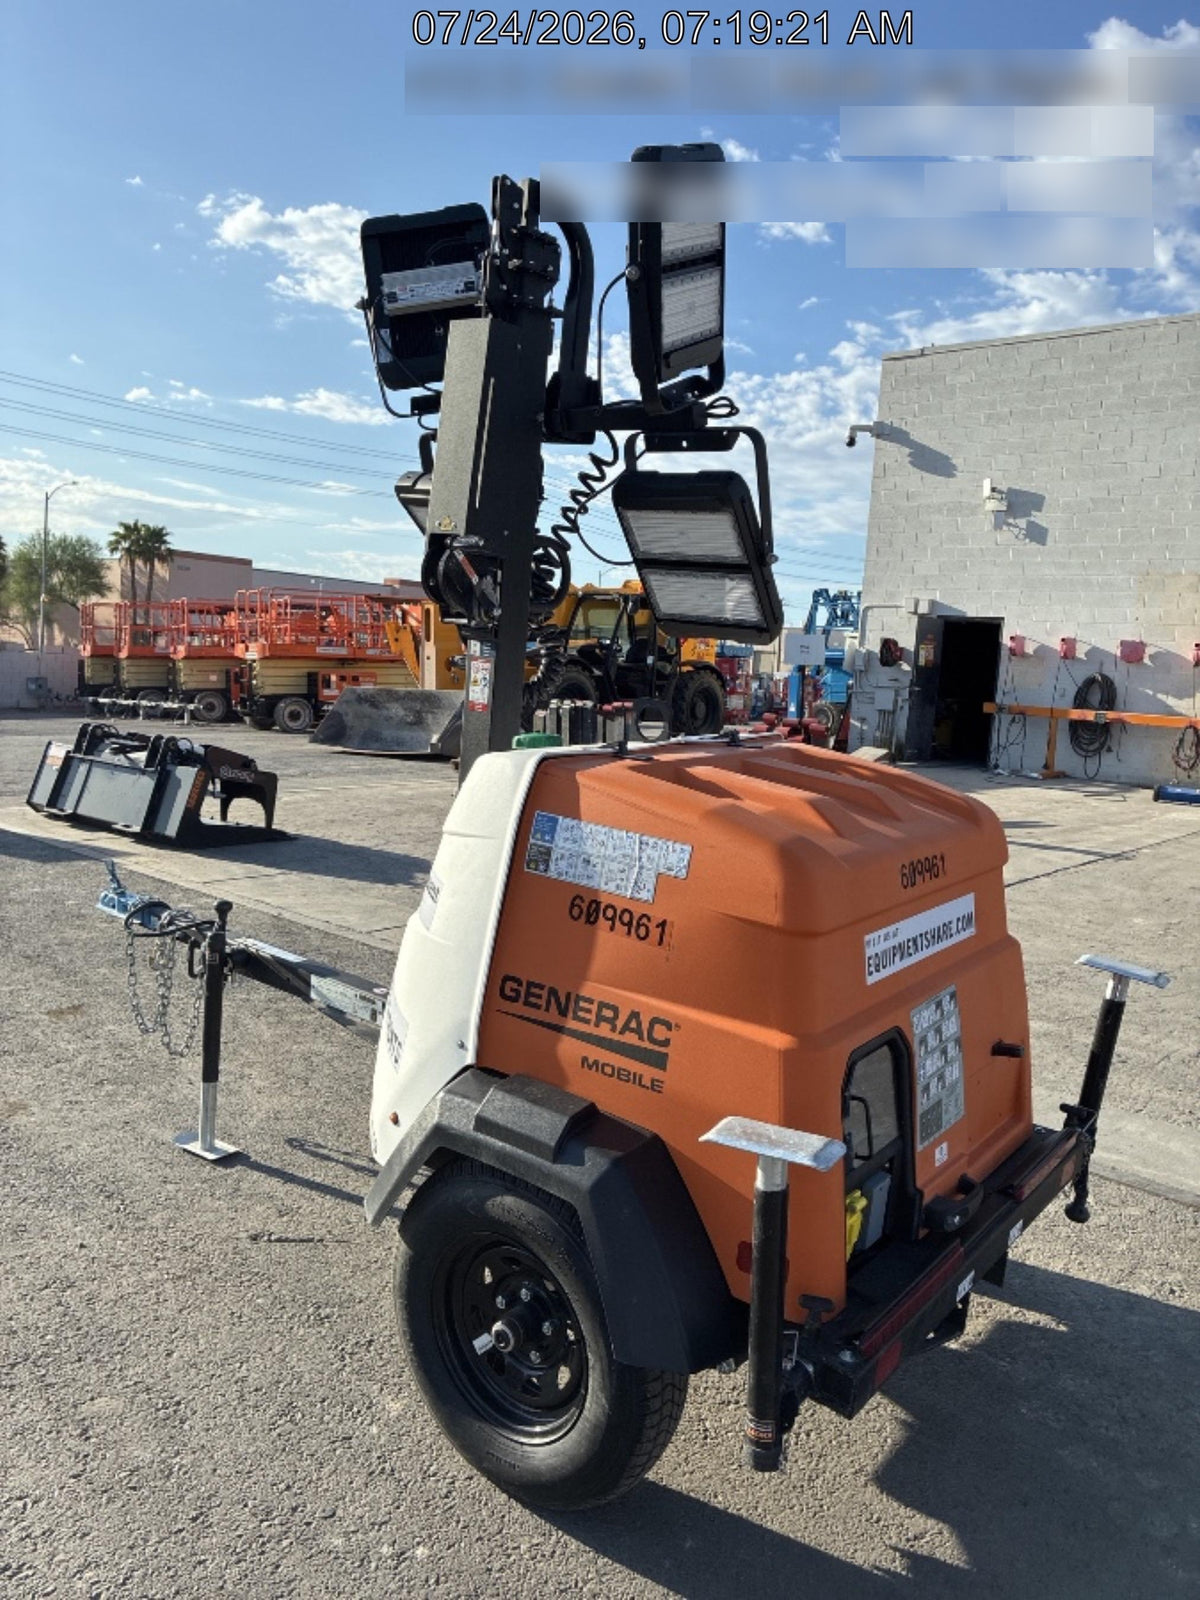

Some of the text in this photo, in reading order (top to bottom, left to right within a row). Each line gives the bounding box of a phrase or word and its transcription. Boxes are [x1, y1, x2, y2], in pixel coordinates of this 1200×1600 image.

[900, 851, 946, 889] 609961
[568, 894, 668, 947] 609961
[866, 911, 974, 977] EQUIPMENTSHARE.COM
[499, 974, 673, 1048] GENERAC
[580, 1055, 665, 1094] MOBILE
